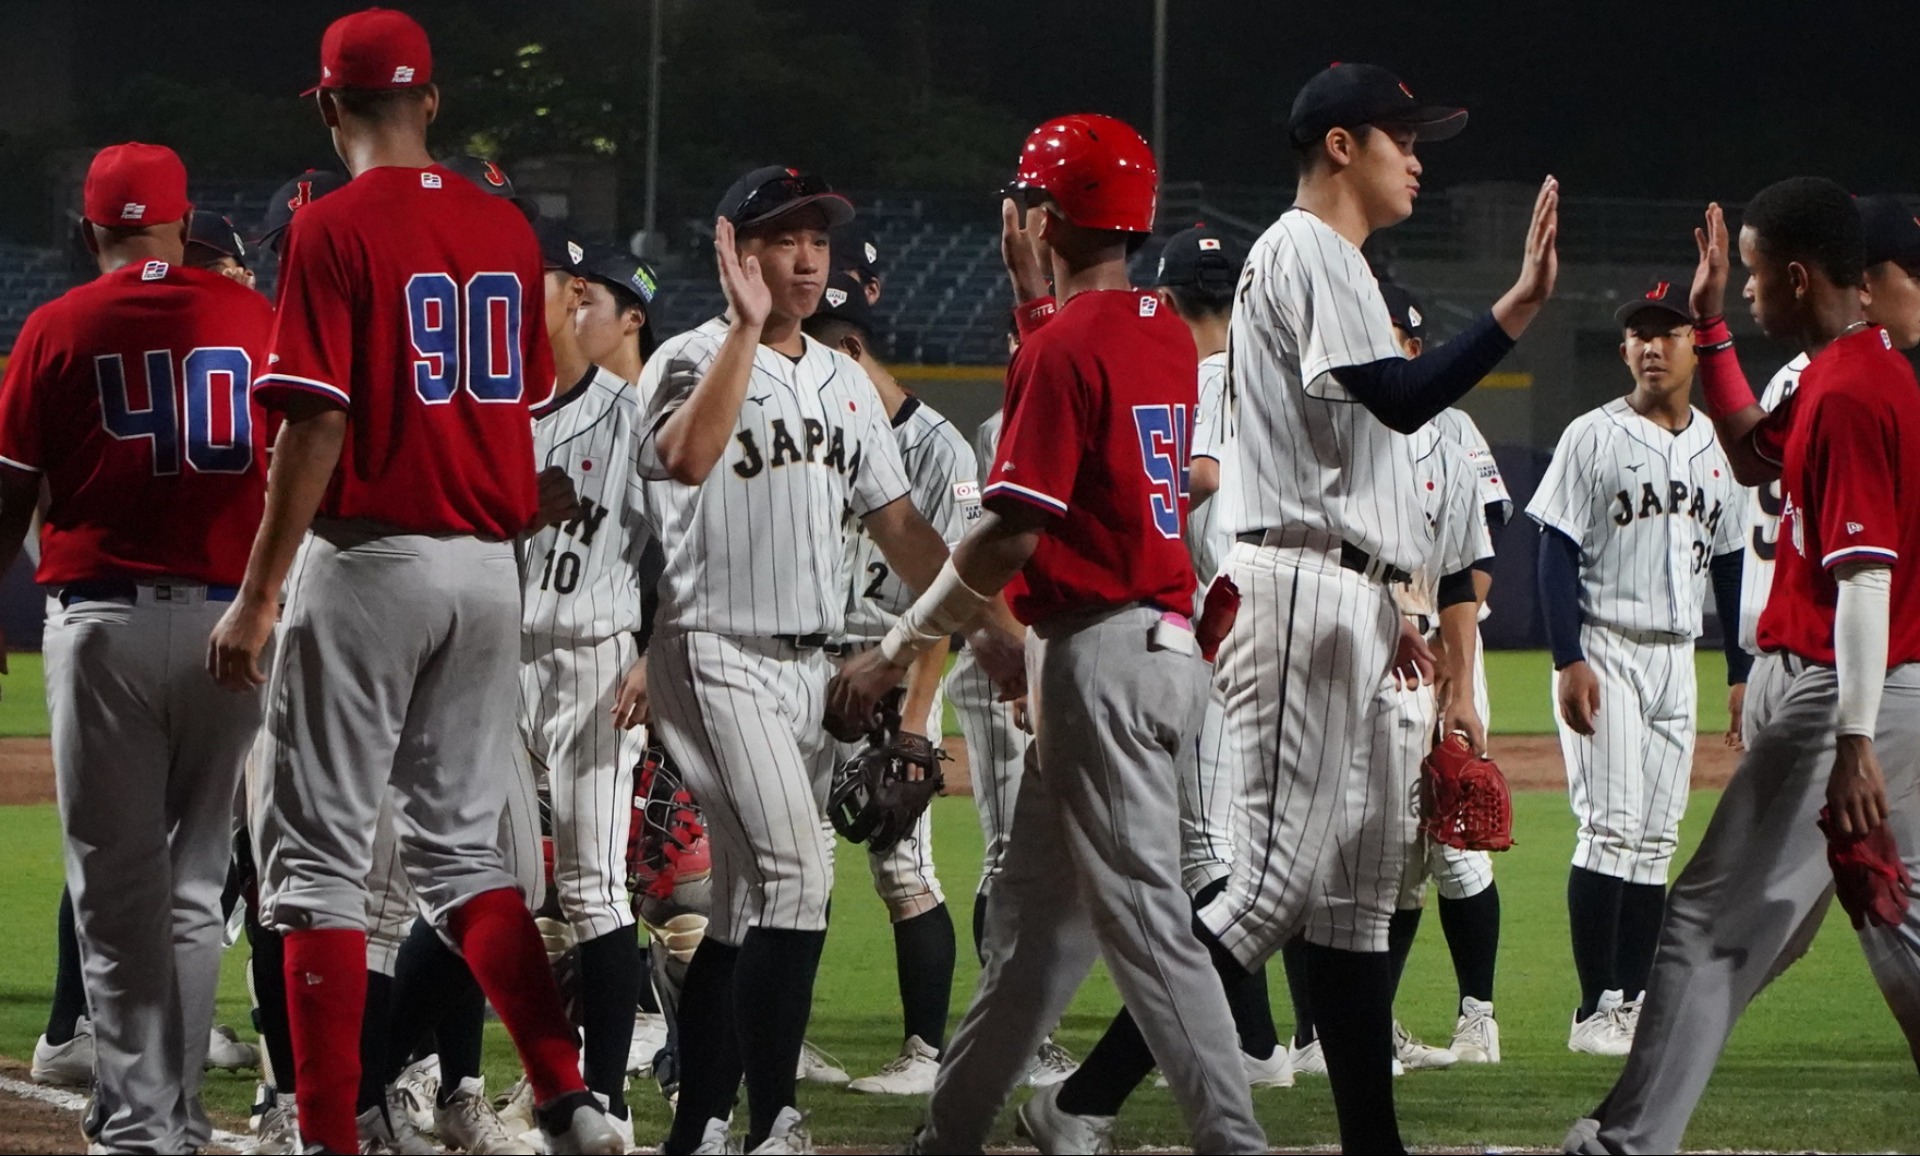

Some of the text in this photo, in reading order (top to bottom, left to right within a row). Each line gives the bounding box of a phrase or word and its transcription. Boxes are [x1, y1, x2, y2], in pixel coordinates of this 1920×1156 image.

[1646, 282, 1671, 301] J
[405, 273, 524, 405] 90
[94, 347, 253, 477] 40
[540, 548, 581, 595] 10
